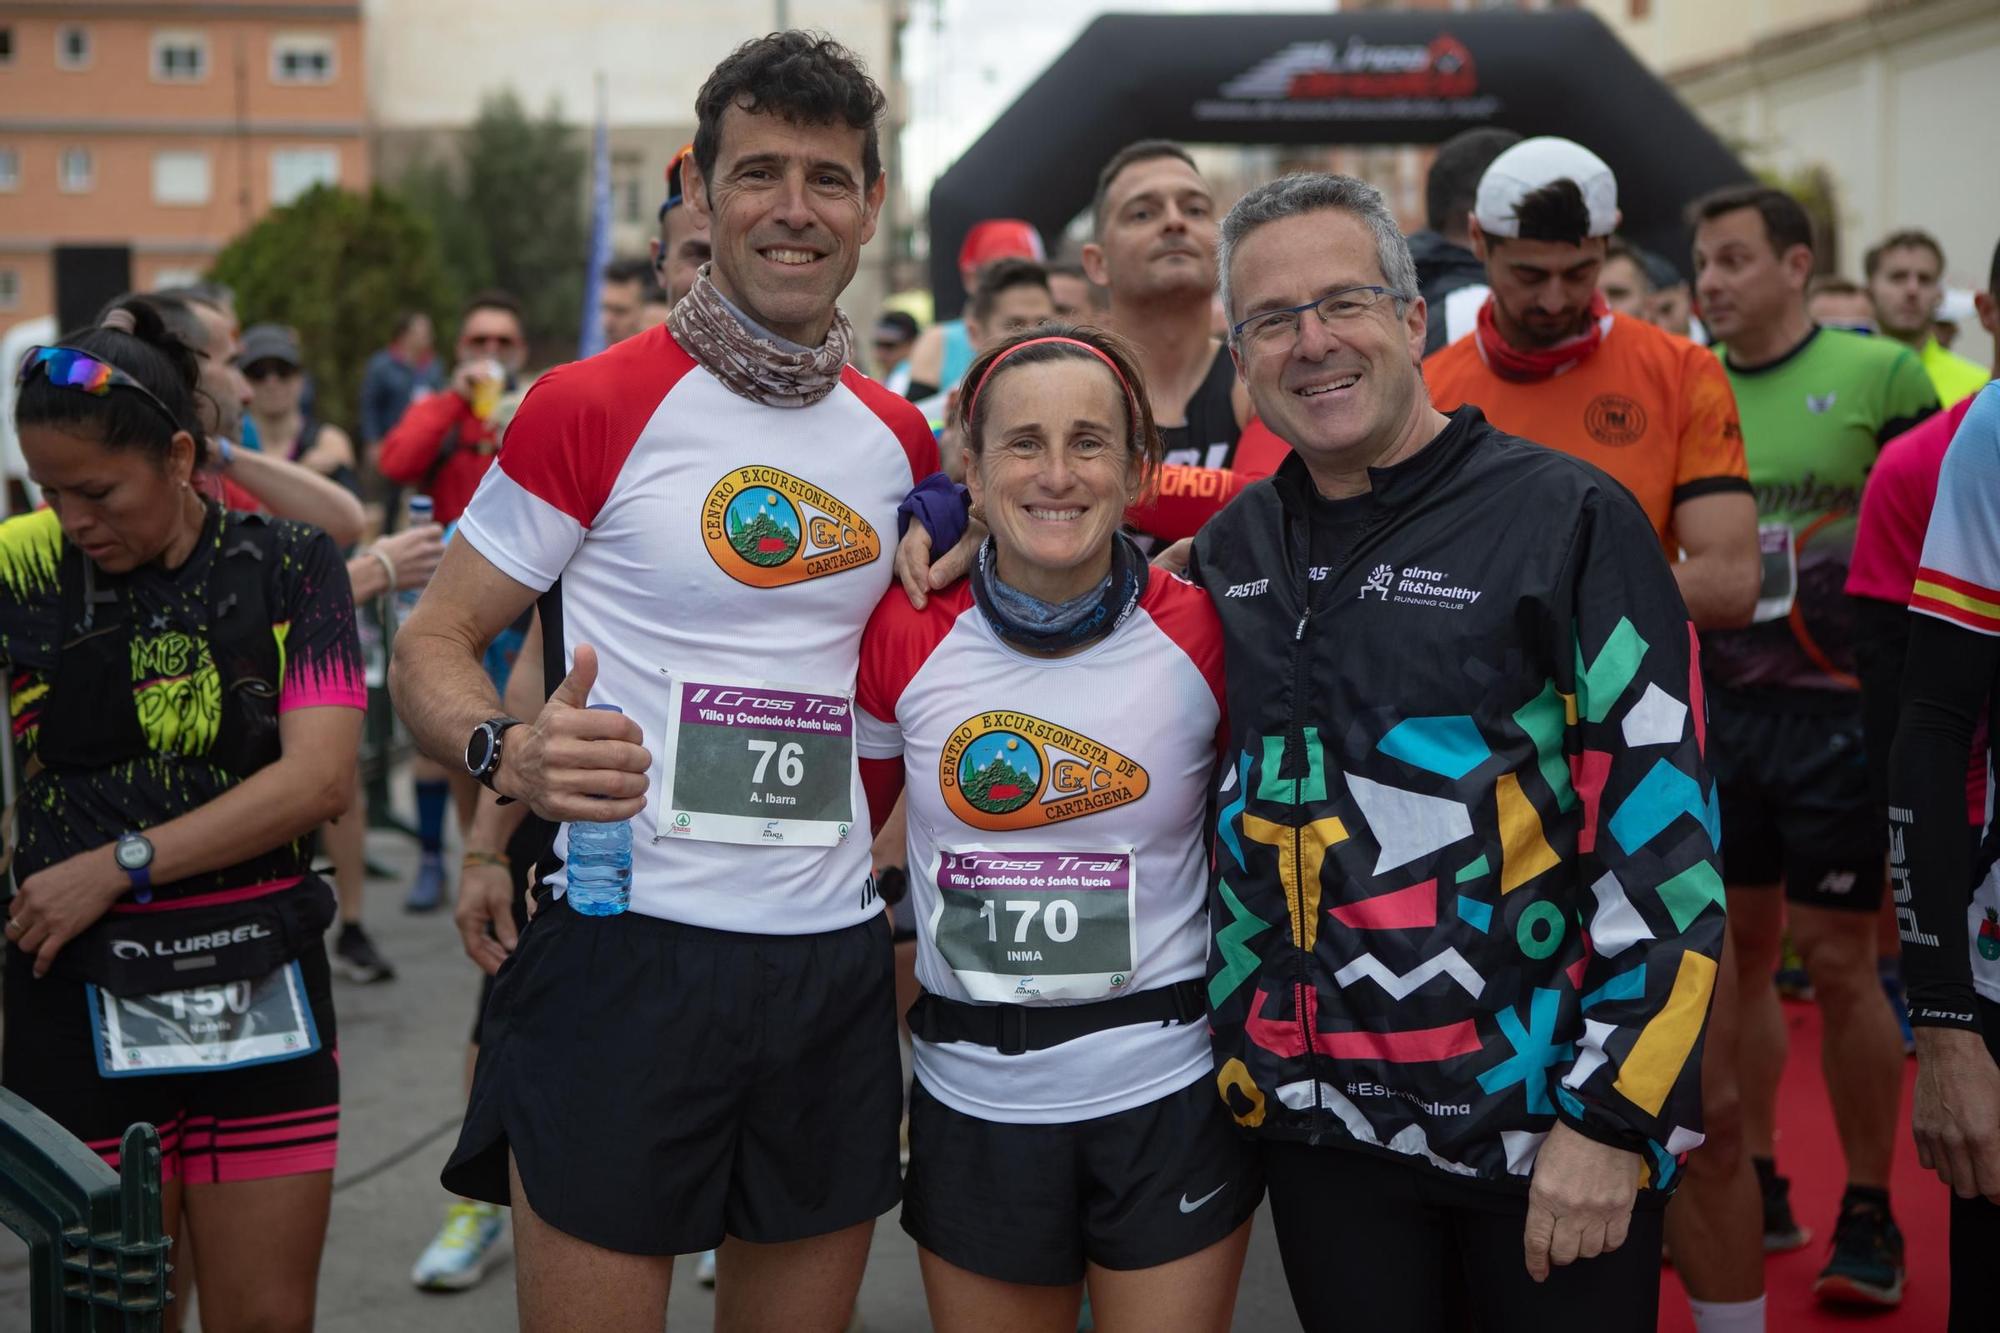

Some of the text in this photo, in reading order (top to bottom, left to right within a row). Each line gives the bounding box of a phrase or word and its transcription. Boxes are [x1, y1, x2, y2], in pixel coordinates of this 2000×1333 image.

[708, 468, 872, 540] CENTRO EXCURSIONISTA DE
[807, 546, 873, 575] CARTAGENA
[1402, 566, 1443, 581] alma
[1224, 578, 1270, 598] FASTER
[1398, 579, 1482, 603] fit&healthy
[1394, 595, 1464, 610] RUNNING CLUB
[713, 690, 796, 711] Cross
[805, 698, 848, 717] Trail
[699, 709, 724, 722] Villa
[727, 714, 735, 725] y
[736, 712, 784, 727] Condado
[784, 717, 796, 727] de
[797, 717, 821, 730] Santa
[944, 714, 1137, 787] CENTRO EXCURSIONISTA DE
[747, 739, 804, 787] 76
[750, 792, 796, 805] A. Ibarra
[1045, 787, 1133, 820] CARTAGENA
[962, 855, 1044, 871] Cross
[1057, 856, 1123, 872] Trail
[951, 874, 969, 886] Villa
[975, 875, 1028, 886] Condado
[1030, 875, 1045, 886] de
[1047, 875, 1079, 887] Santa
[979, 899, 1079, 943] 170
[155, 923, 271, 956] LURBEL
[1007, 950, 1043, 962] INMA
